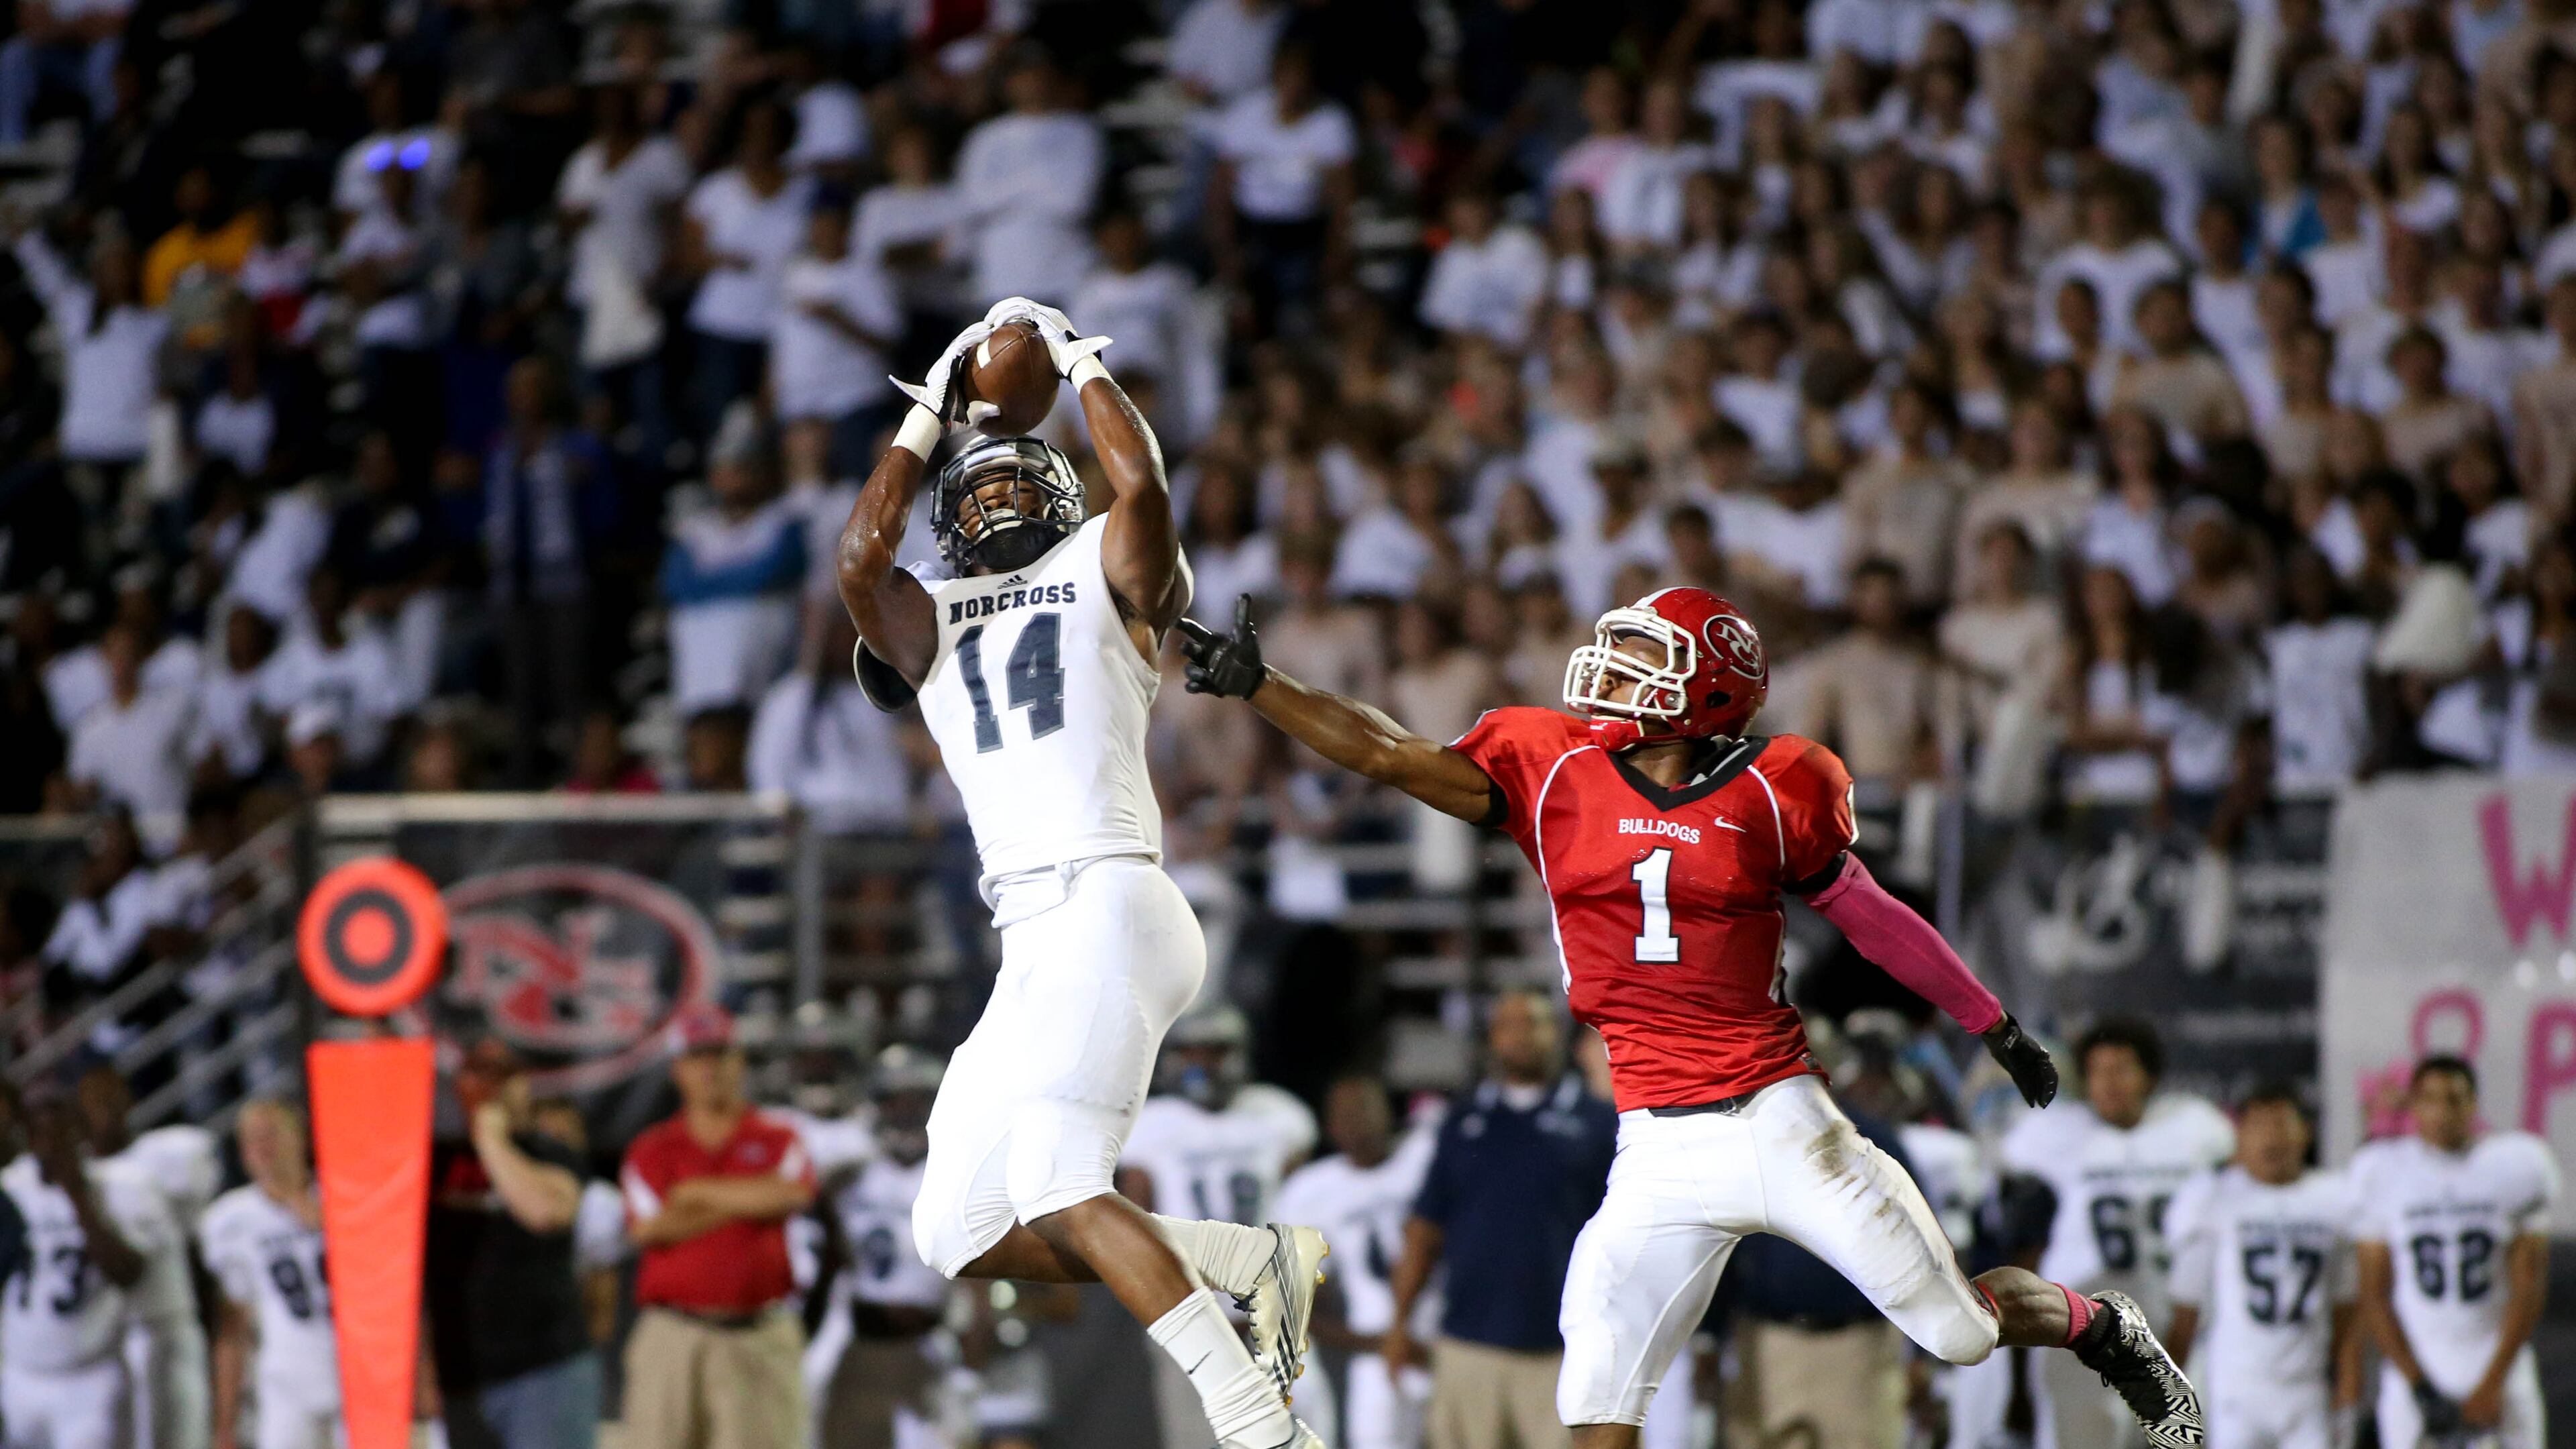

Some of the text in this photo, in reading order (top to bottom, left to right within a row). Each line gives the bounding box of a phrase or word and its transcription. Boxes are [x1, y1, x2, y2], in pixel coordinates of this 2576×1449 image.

[949, 582, 1077, 625] NORCROSS
[956, 612, 1065, 754] 14
[1618, 818, 1701, 844] BULLDOGS
[1631, 846, 1678, 965] 1
[2243, 1244, 2323, 1324] 57
[2410, 1229, 2493, 1300] 62
